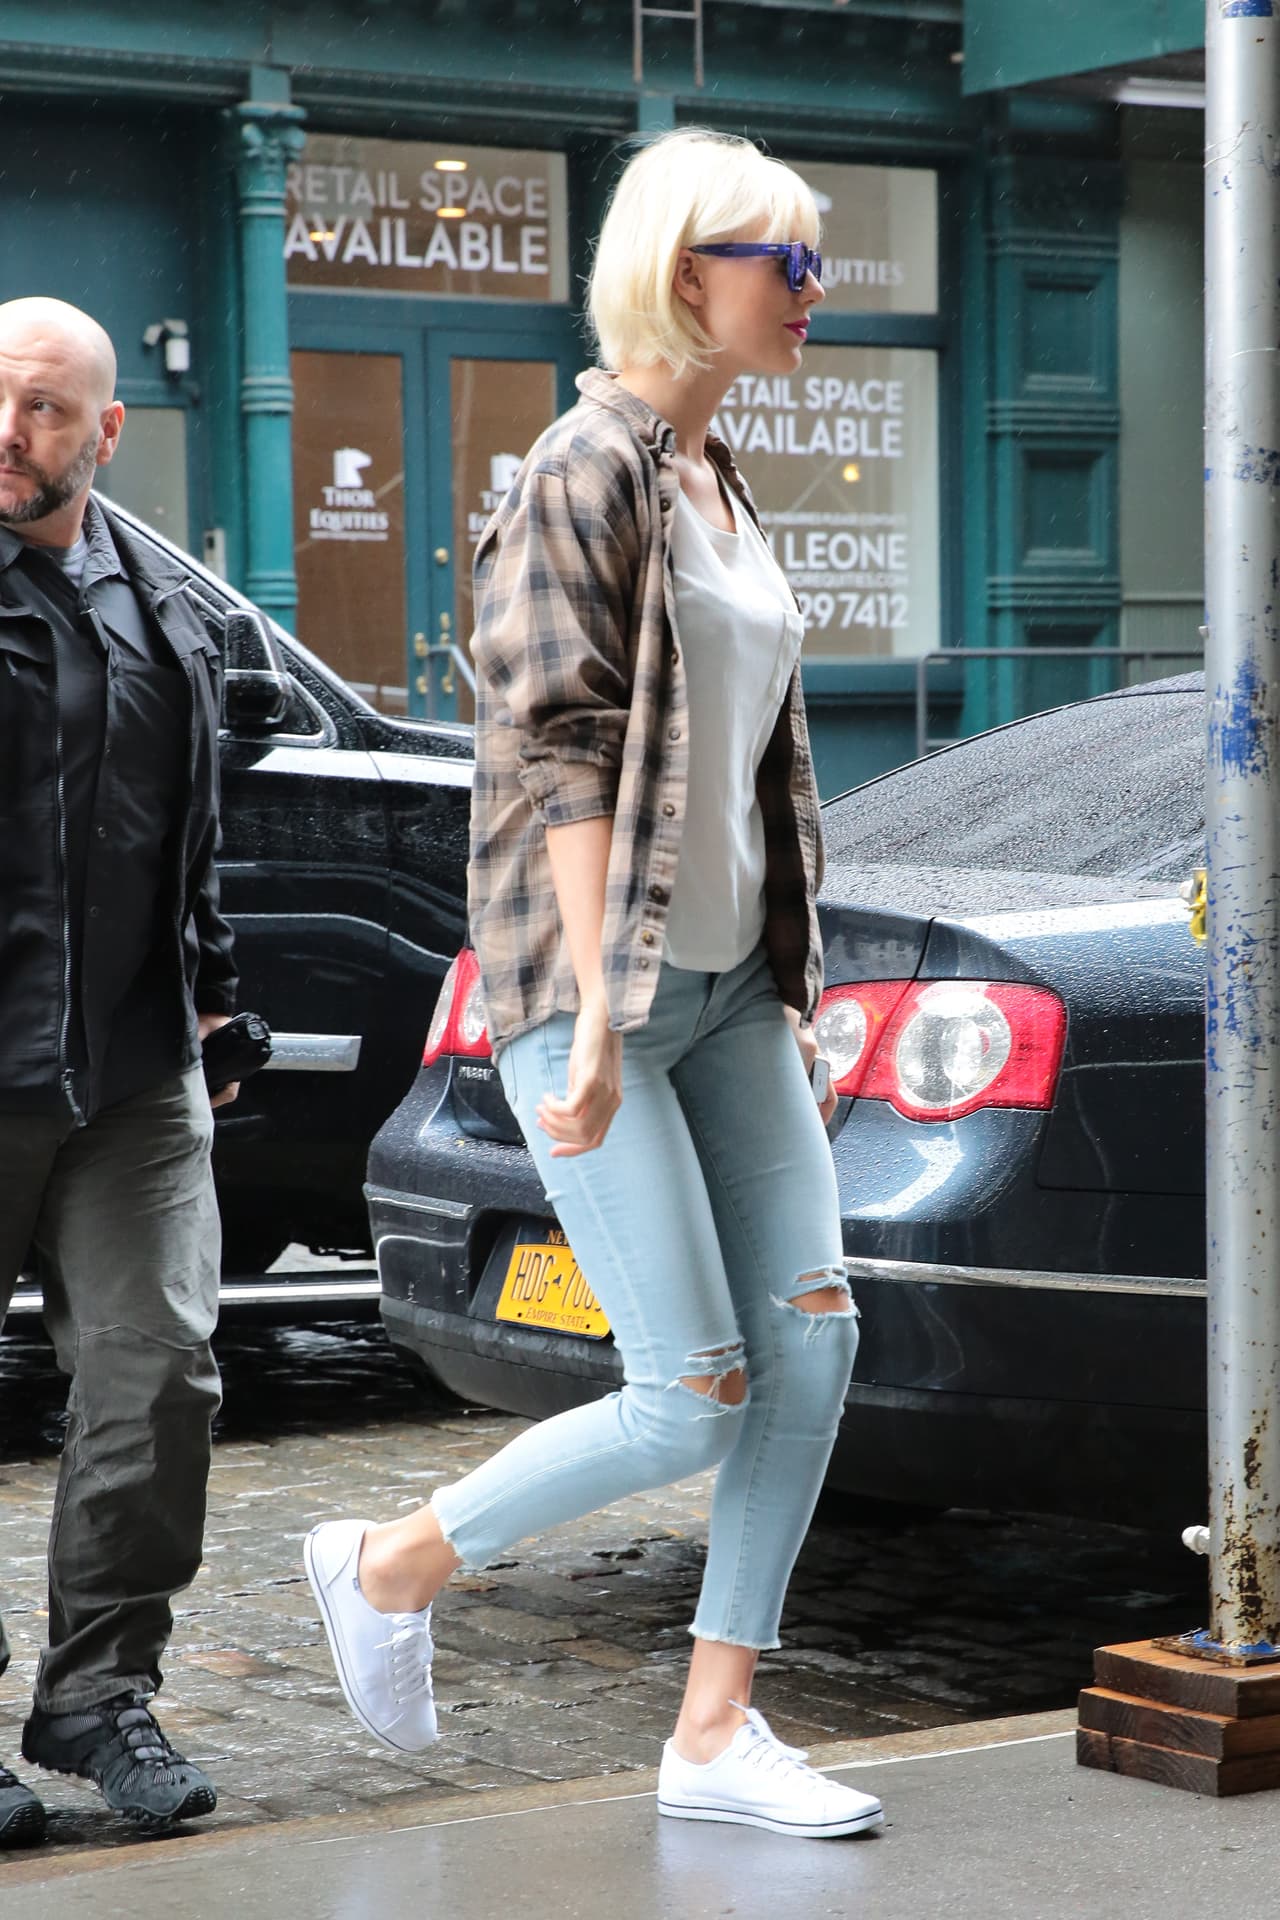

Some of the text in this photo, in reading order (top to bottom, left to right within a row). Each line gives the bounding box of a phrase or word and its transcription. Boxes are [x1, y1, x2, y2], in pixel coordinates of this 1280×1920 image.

[286, 163, 547, 219] RETAIL SPACE
[283, 212, 549, 275] AVAILABLE
[821, 257, 905, 288] UITIES
[721, 374, 905, 414] ETAIL SPACE
[784, 532, 907, 570] LEONE
[799, 592, 908, 629] 29 7412
[546, 1229, 569, 1246] NE
[525, 1306, 586, 1329] EMPIRE STATE
